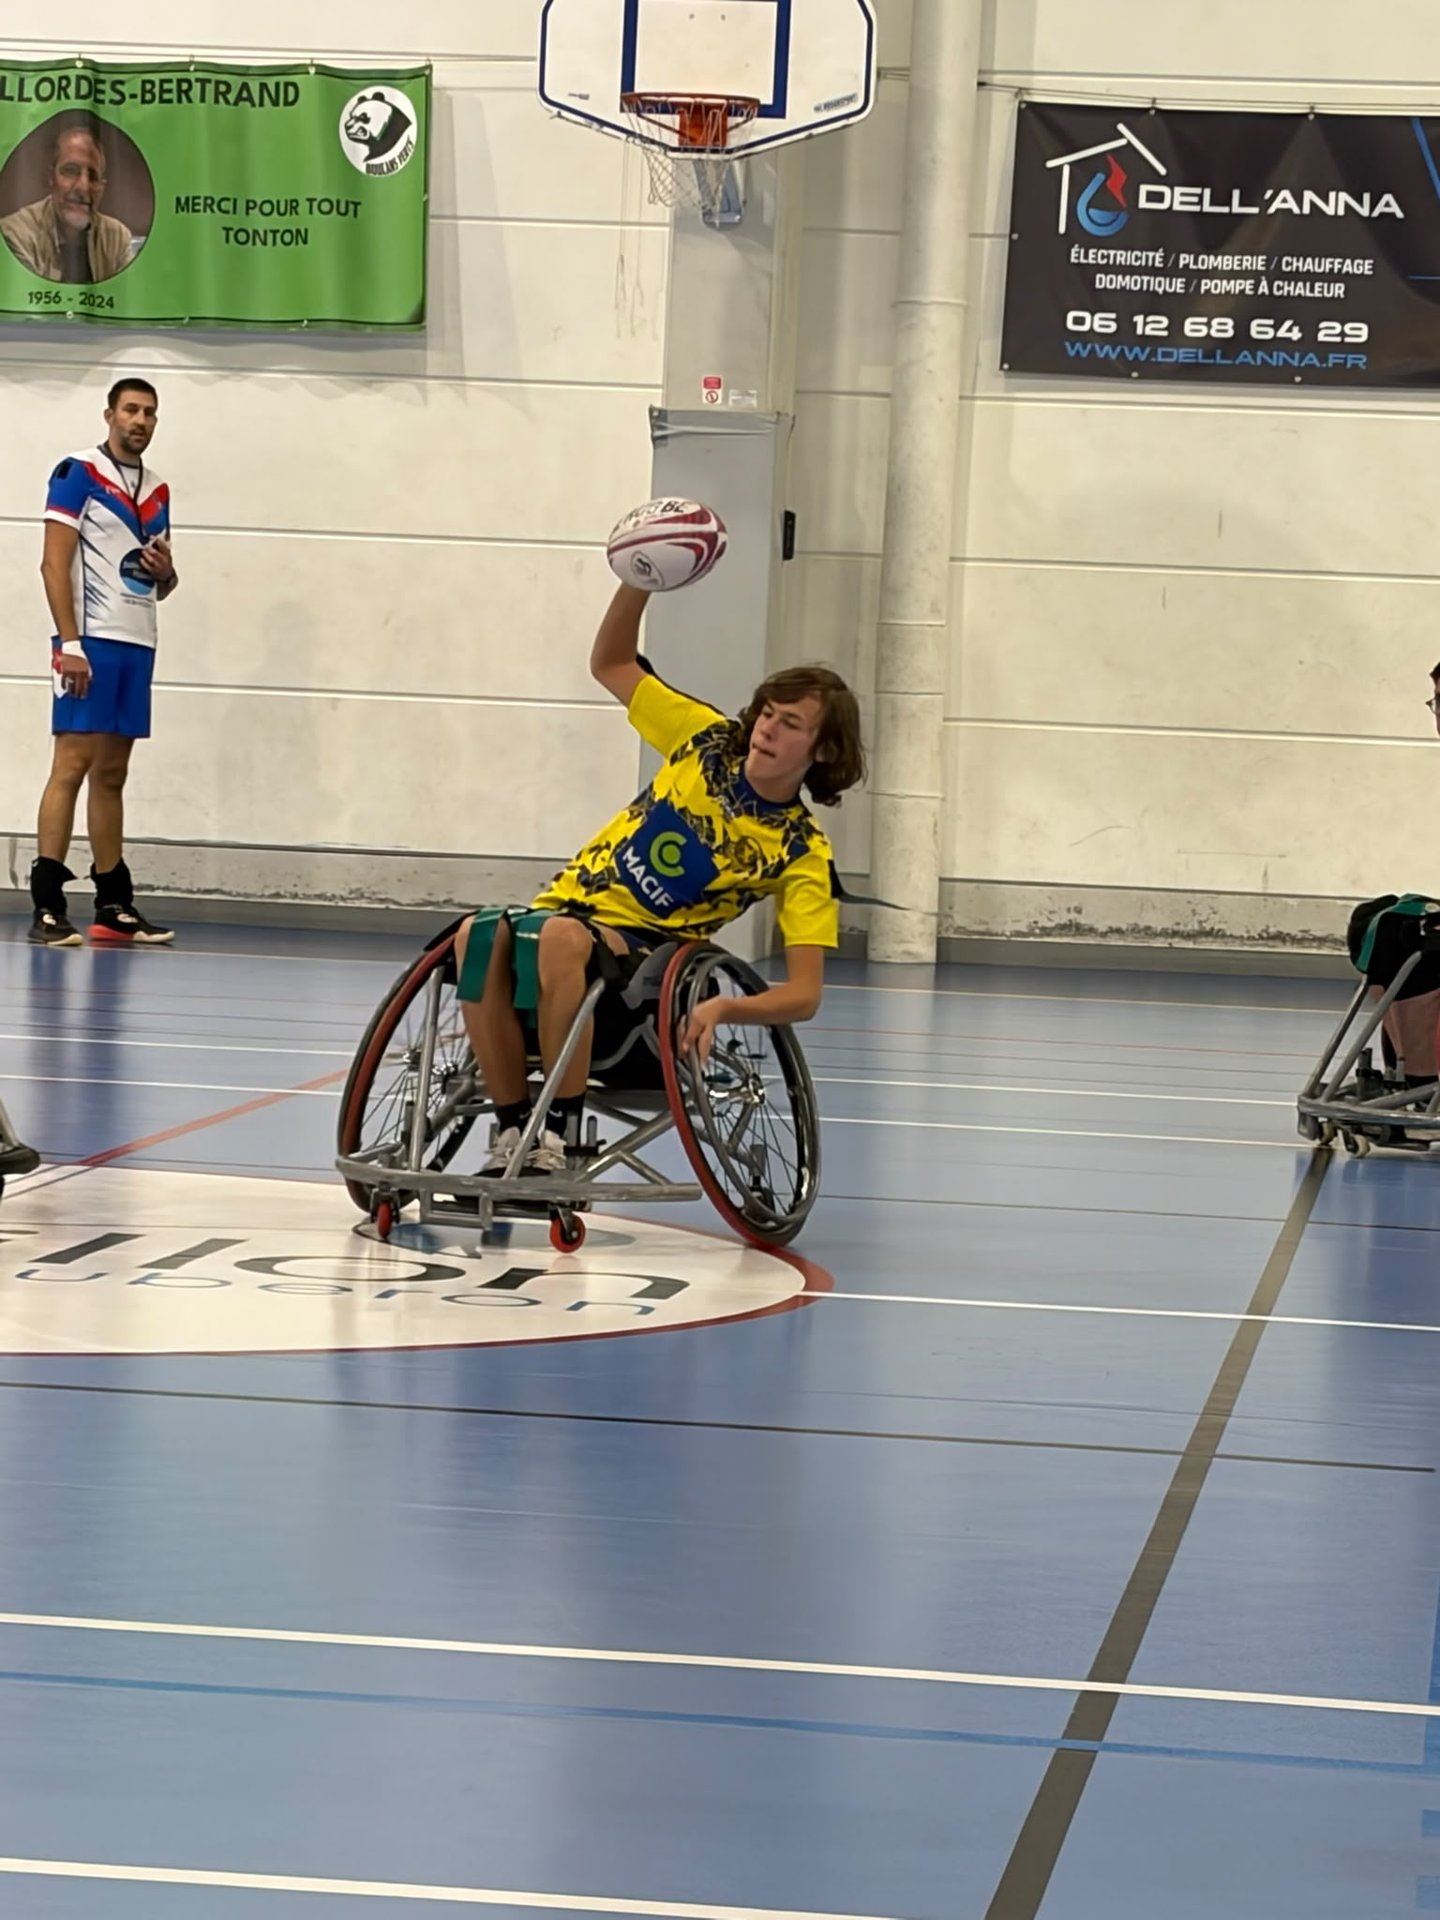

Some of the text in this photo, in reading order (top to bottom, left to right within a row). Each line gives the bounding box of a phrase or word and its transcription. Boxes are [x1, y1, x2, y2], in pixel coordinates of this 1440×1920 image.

[0, 74, 300, 107] LLORDES-BERTRAND
[175, 195, 362, 218] MERCI POUR TOUT
[1138, 184, 1405, 219] DELL'ANNA
[222, 226, 309, 247] TONTON
[1070, 244, 1165, 268] ÉLECTRICITÉ
[1178, 253, 1267, 271] PLOMBERIE
[1281, 256, 1375, 275] CHAUFFAGE
[28, 290, 62, 304] 1956
[78, 291, 115, 309] 2024
[1095, 273, 1187, 294] DOMOTIQUE
[1200, 280, 1255, 296] POMPE
[1257, 276, 1270, 296] À
[1272, 280, 1346, 299] CHALEUR
[1066, 310, 1370, 344] 06 12 68 64 29
[1064, 340, 1369, 370] WWW.DELLANNA.FR
[622, 845, 674, 907] MACIF
